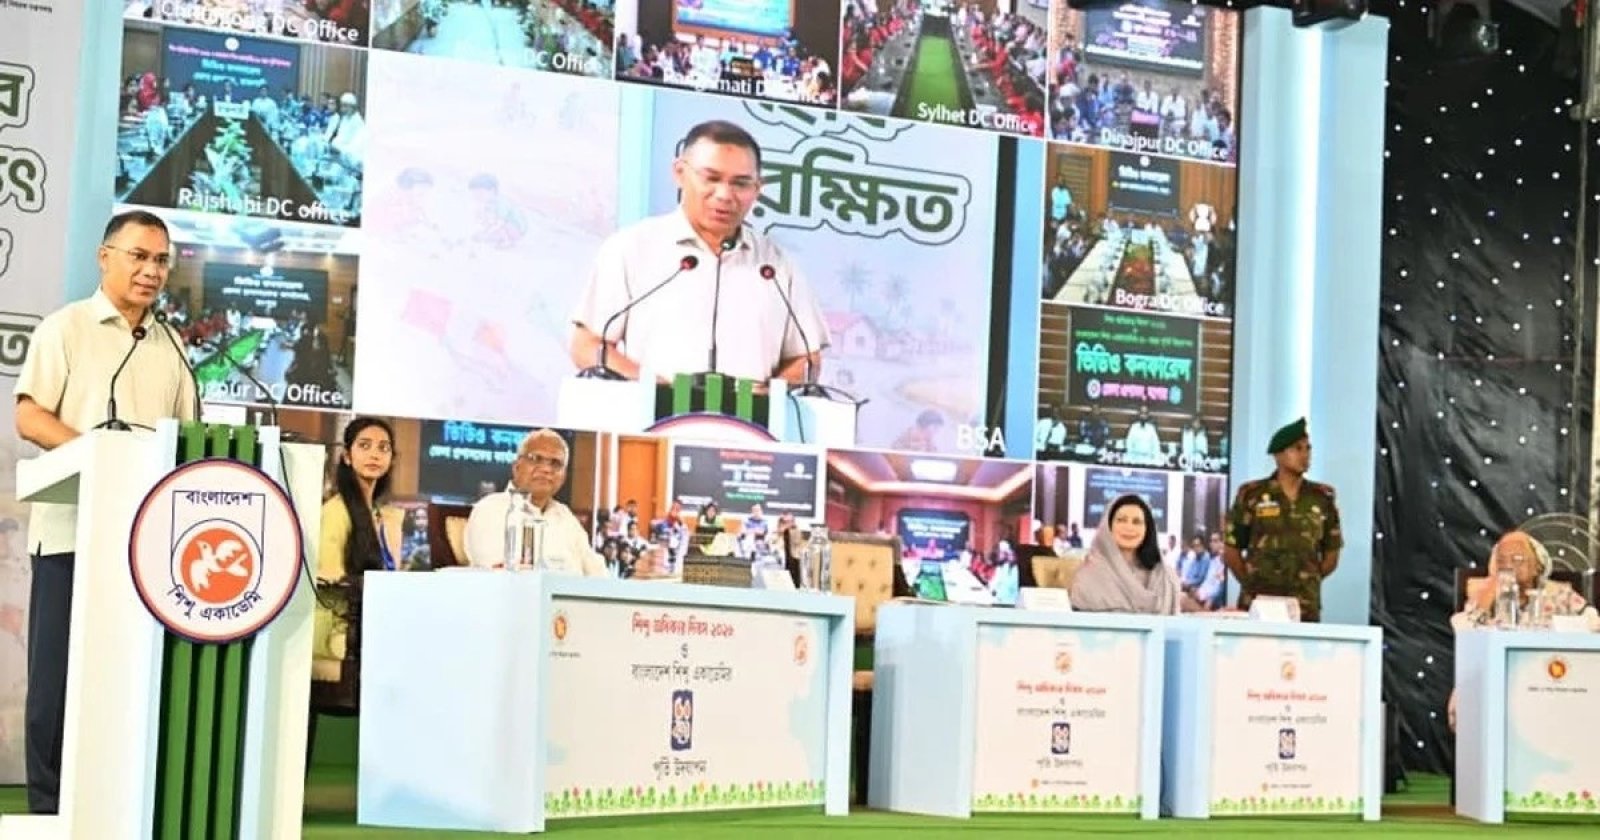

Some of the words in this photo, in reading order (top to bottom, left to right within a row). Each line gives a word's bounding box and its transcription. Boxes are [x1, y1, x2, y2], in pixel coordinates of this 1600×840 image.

[272, 13, 300, 33] DC
[304, 18, 359, 41] Office
[918, 102, 966, 123] Sylhet
[969, 109, 992, 127] DC
[993, 112, 1037, 133] Office
[1101, 127, 1160, 152] Dinajpur
[1164, 136, 1185, 154] DC
[178, 187, 261, 214] Rajshhi
[267, 196, 293, 217] DC
[298, 201, 350, 223] office
[1115, 288, 1158, 310] Bogra
[956, 423, 1006, 452] BSA
[185, 490, 253, 506] বাংলাদেশ
[167, 584, 196, 620] শিশু
[200, 591, 263, 621] একাডেমি
